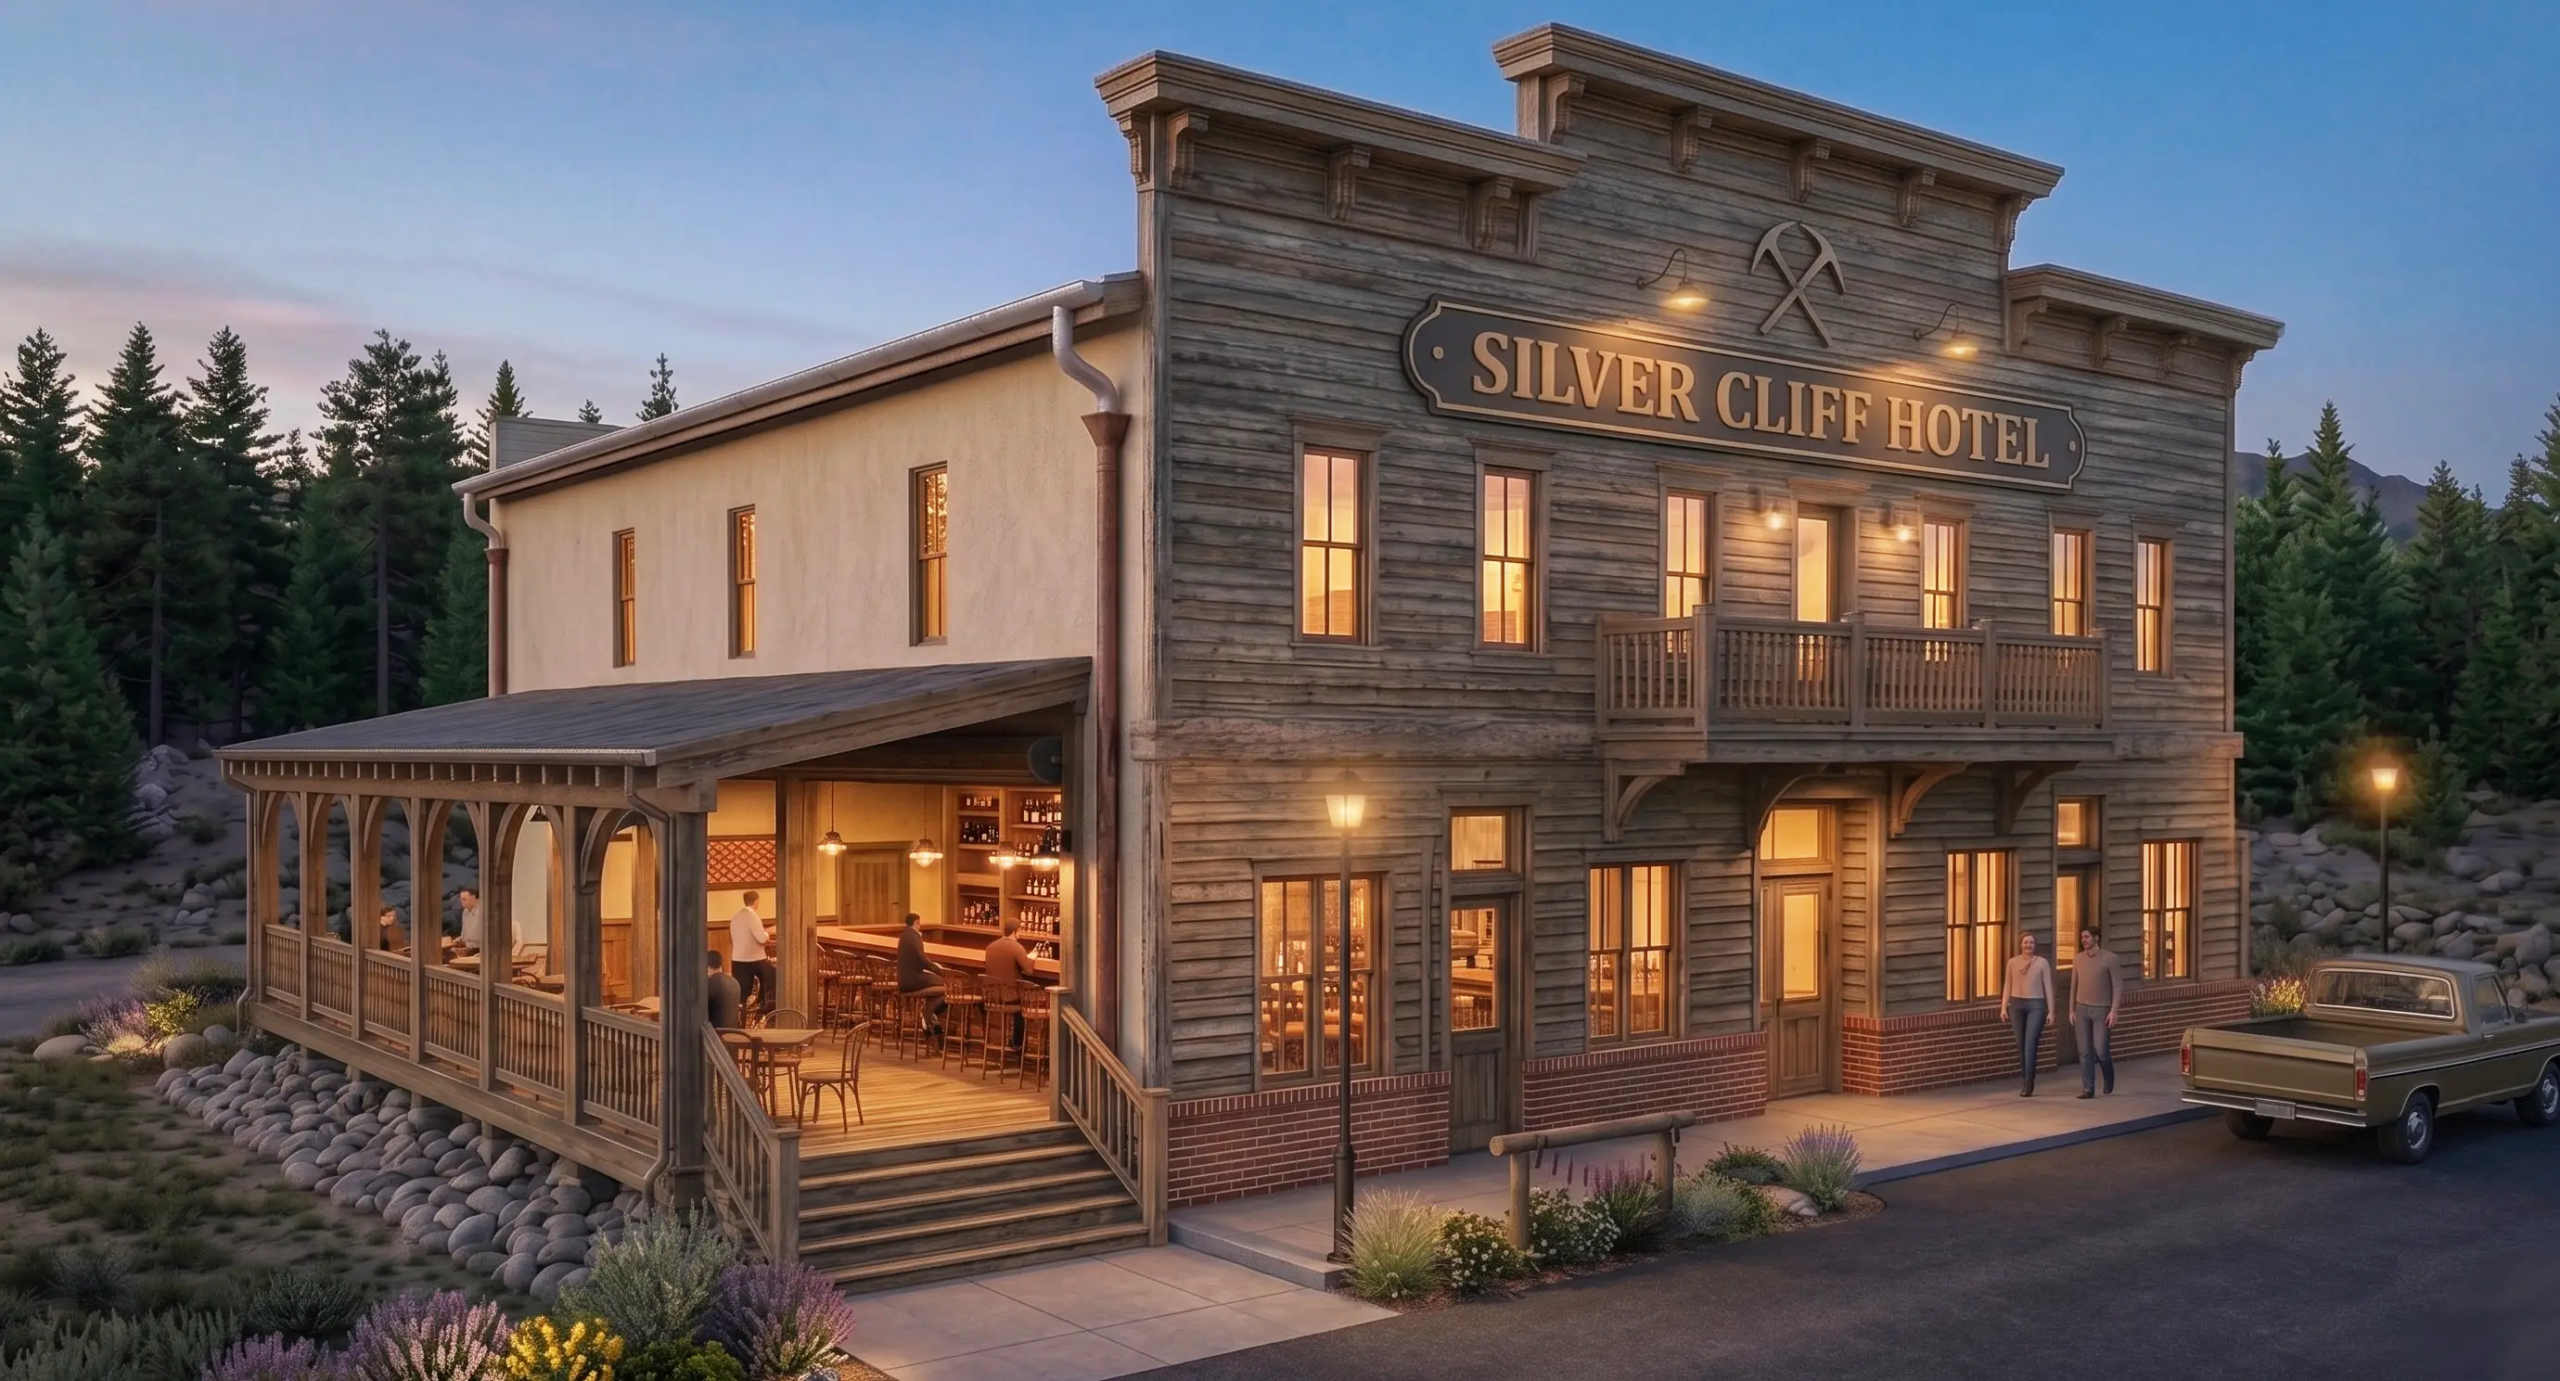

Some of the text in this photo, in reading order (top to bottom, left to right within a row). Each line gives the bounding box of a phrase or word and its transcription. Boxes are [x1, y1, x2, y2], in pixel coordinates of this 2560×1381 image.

[1472, 331, 2049, 468] SILVER CLIFF HOTEL
